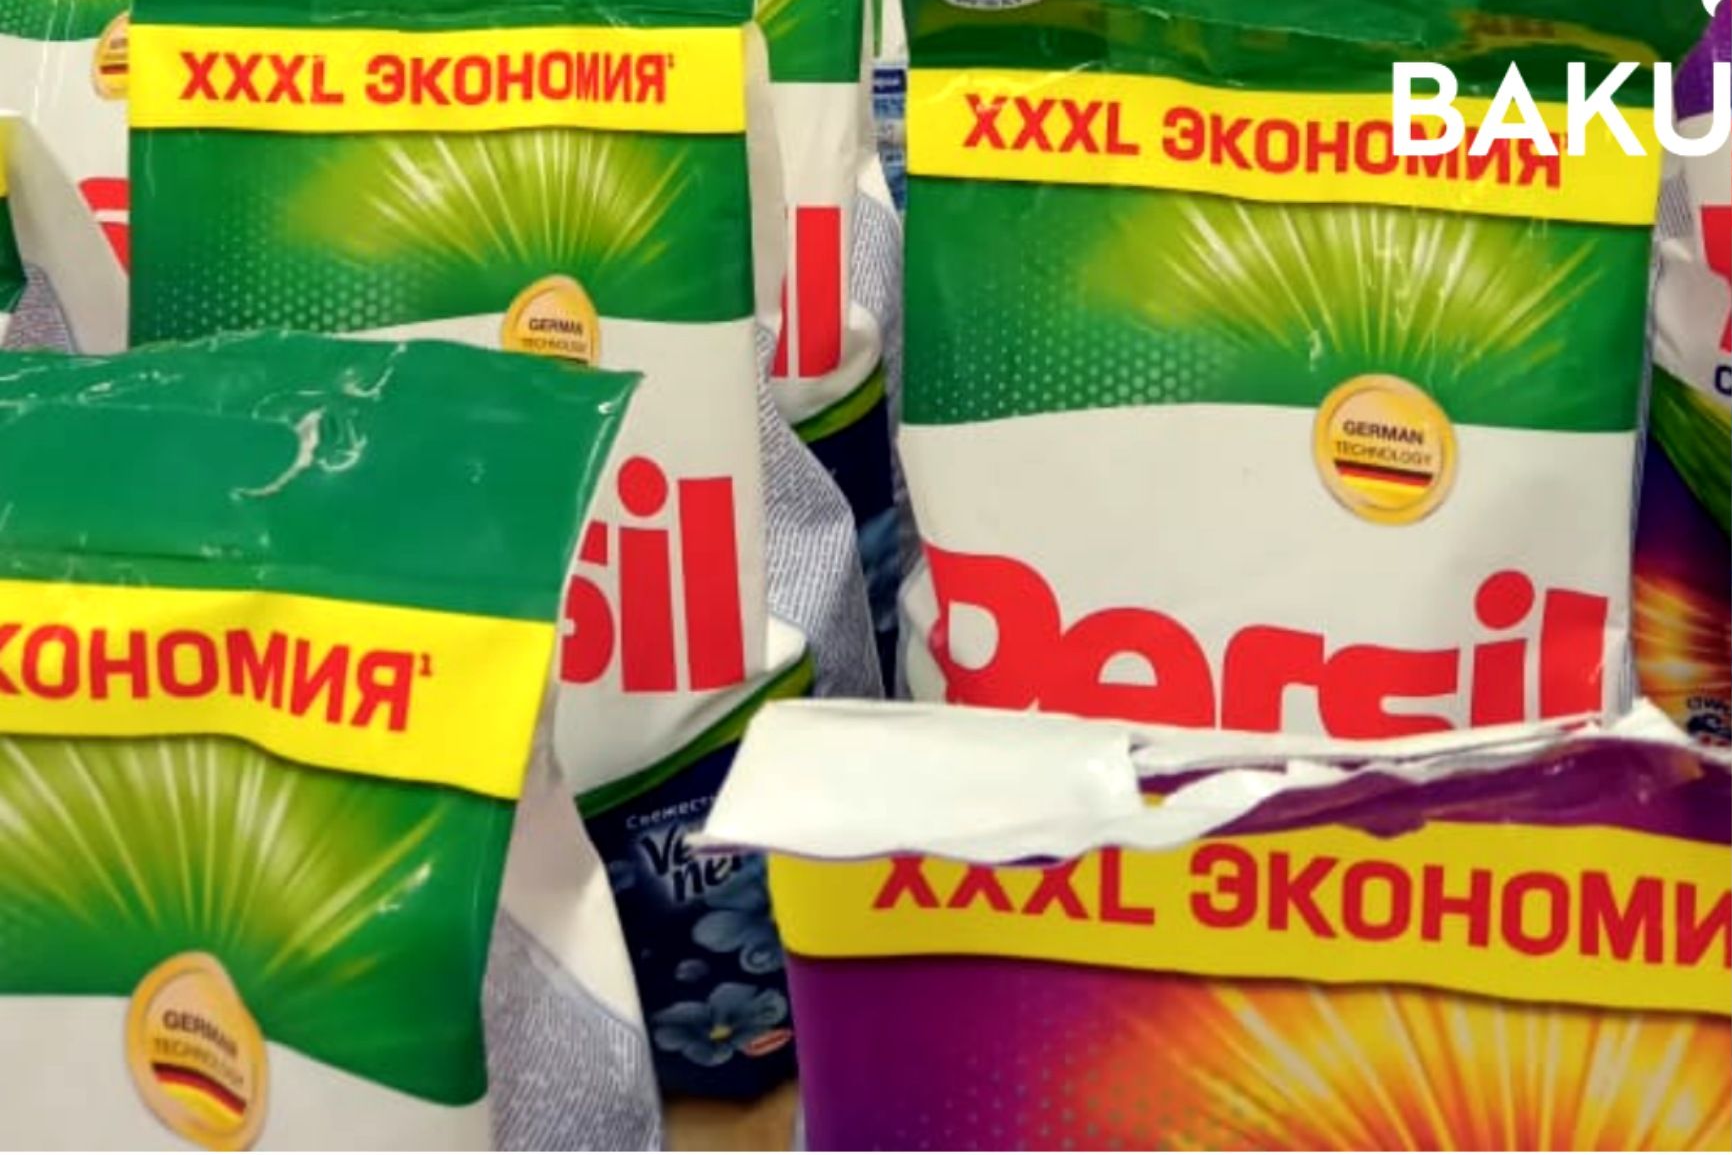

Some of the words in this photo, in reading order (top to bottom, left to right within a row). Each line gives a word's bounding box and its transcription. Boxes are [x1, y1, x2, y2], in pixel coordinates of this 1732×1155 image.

[179, 51, 345, 107] XXXL
[963, 93, 1140, 157] XXXL
[1334, 440, 1434, 468] TECHNOLOGY
[1343, 418, 1425, 446] GERMAN
[923, 541, 1610, 742] Persil
